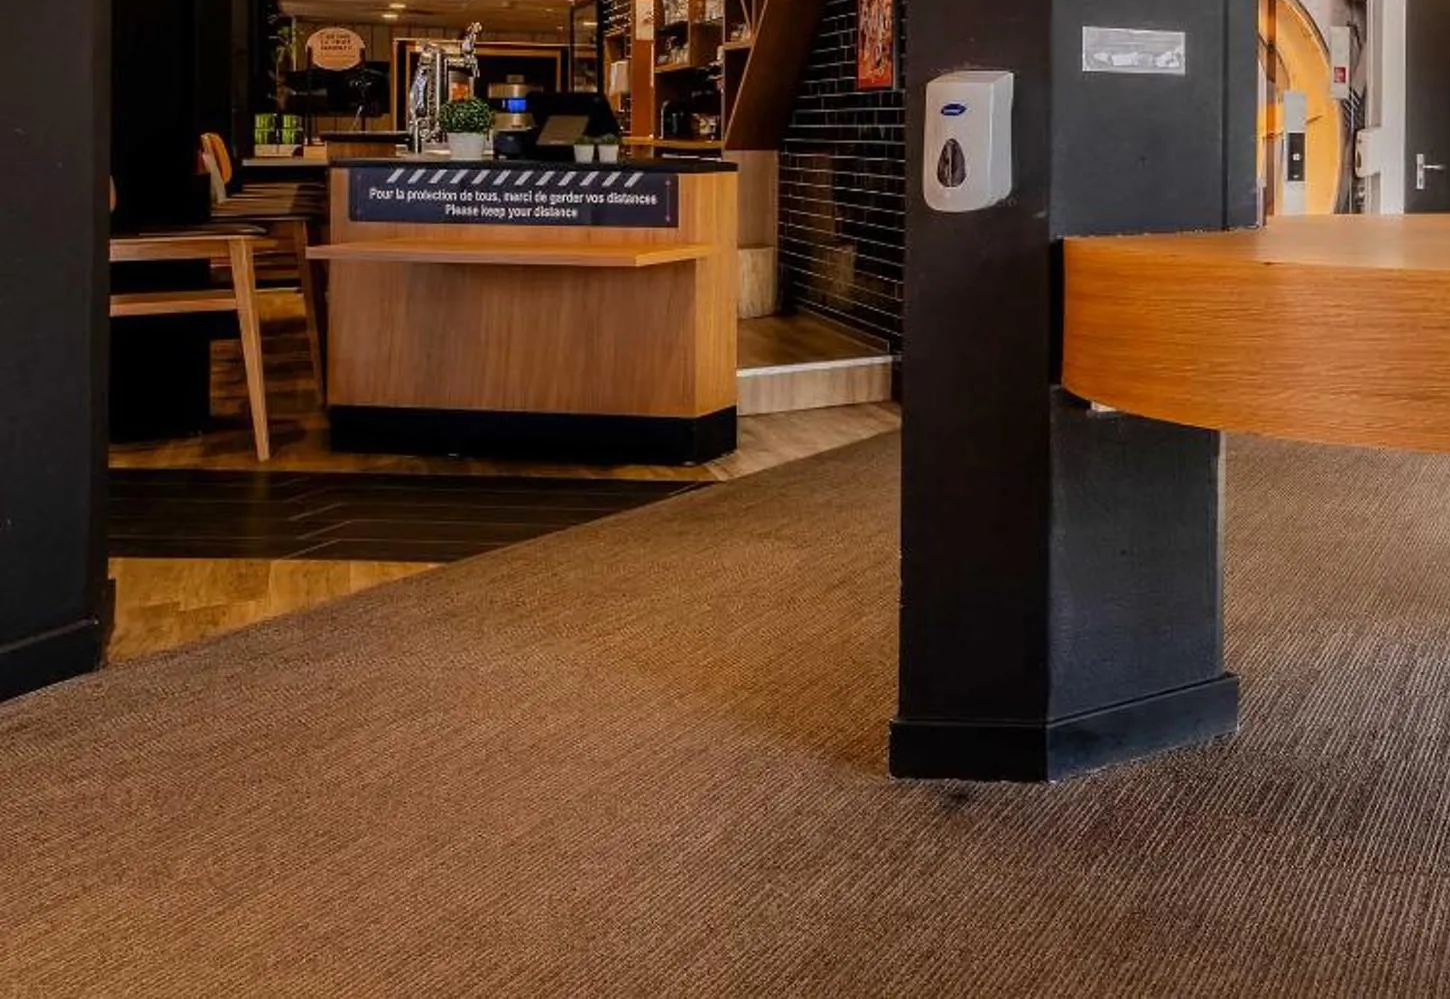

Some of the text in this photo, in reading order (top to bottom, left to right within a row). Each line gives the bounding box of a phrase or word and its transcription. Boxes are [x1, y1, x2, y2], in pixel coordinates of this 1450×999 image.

[369, 188, 394, 200] Pour
[396, 188, 405, 200] la
[407, 190, 456, 202] protection
[460, 190, 473, 202] de
[503, 190, 533, 203] merci
[534, 191, 548, 204] de
[549, 191, 583, 206] garder
[585, 193, 604, 204] vos
[607, 192, 658, 205] distances
[445, 204, 578, 219] Please keep your distance
